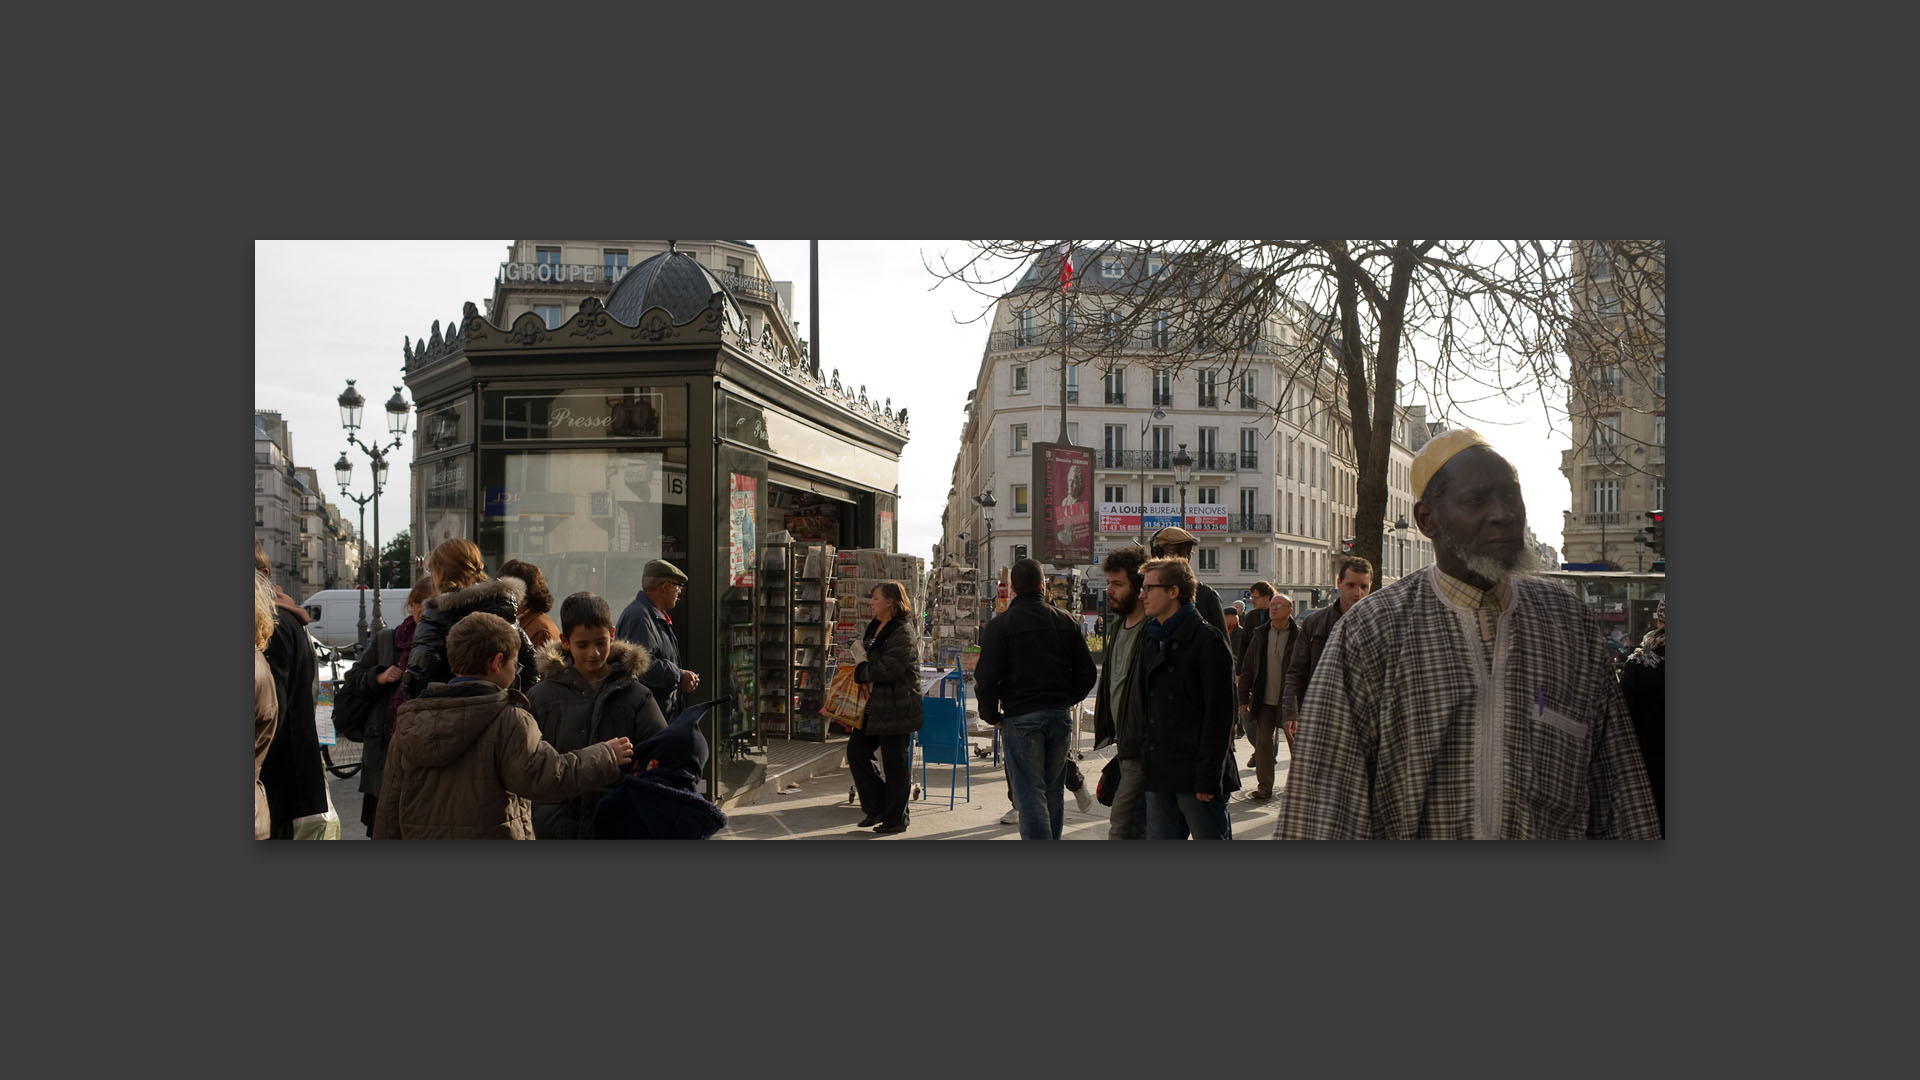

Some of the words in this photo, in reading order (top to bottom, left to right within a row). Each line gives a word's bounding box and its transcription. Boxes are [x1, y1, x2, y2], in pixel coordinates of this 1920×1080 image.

[506, 263, 595, 282] GROUPE
[548, 407, 616, 427] Presse
[1110, 506, 1118, 514] A
[1119, 506, 1148, 514] LOUER
[1189, 506, 1226, 515] RENOVES
